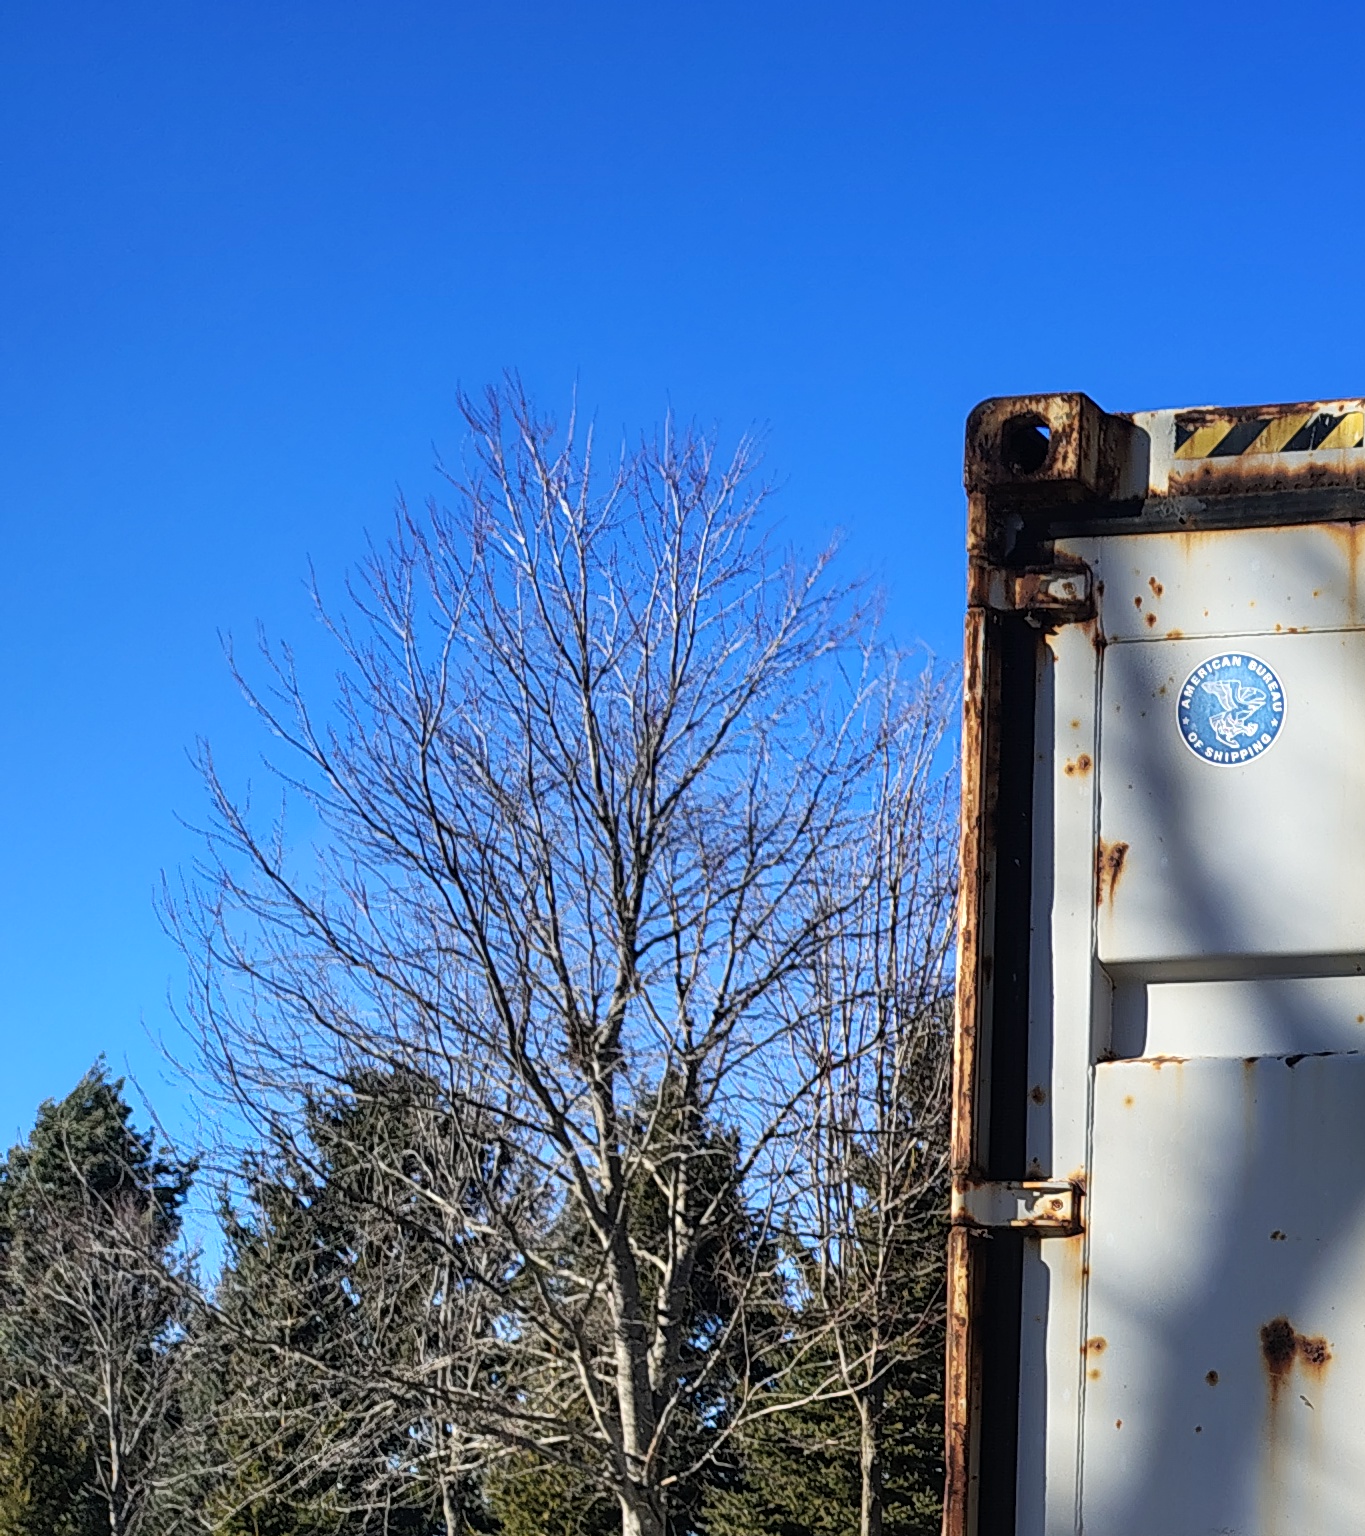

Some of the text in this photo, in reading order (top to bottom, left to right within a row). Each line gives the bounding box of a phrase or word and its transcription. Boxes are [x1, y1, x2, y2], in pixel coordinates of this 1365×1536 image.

[1181, 656, 1282, 712] AMERICAN BUREAU
[1188, 732, 1272, 762] OF SHIPPING
